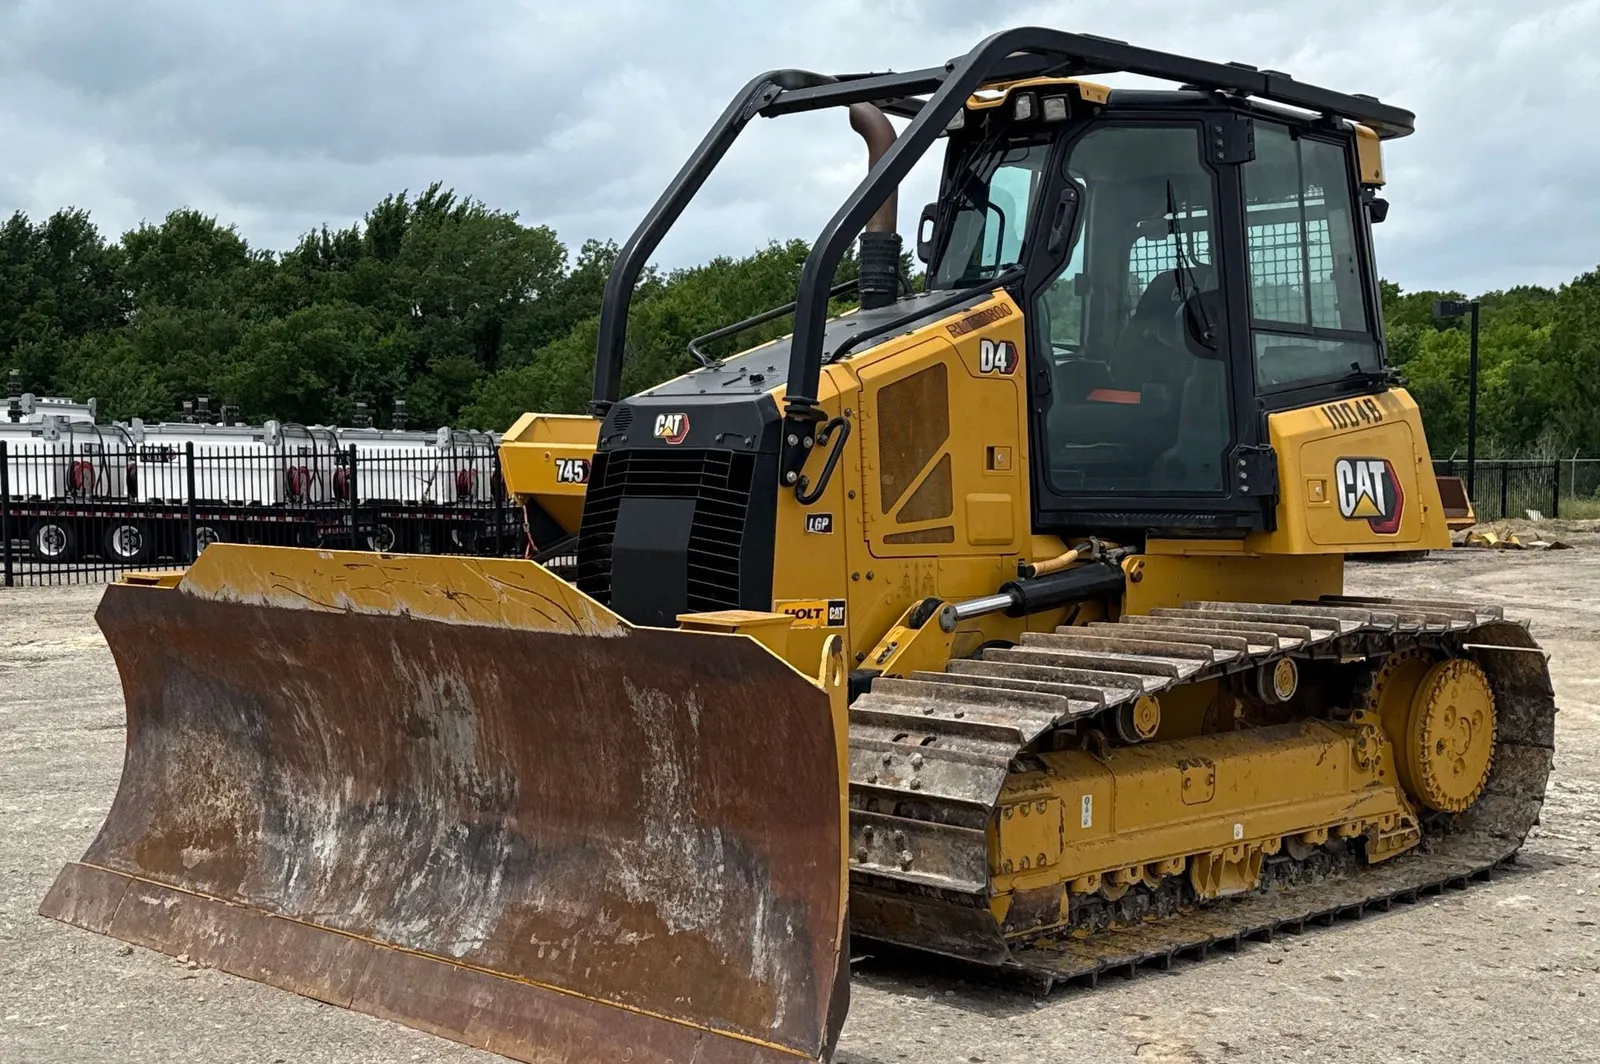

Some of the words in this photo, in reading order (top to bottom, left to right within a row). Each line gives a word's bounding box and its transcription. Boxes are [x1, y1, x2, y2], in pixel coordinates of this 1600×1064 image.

[980, 339, 1007, 373] D4
[655, 414, 682, 437] CAT
[556, 460, 584, 482] 745
[1336, 459, 1386, 517] CAT
[808, 518, 829, 531] LGP
[829, 606, 844, 620] CAT
